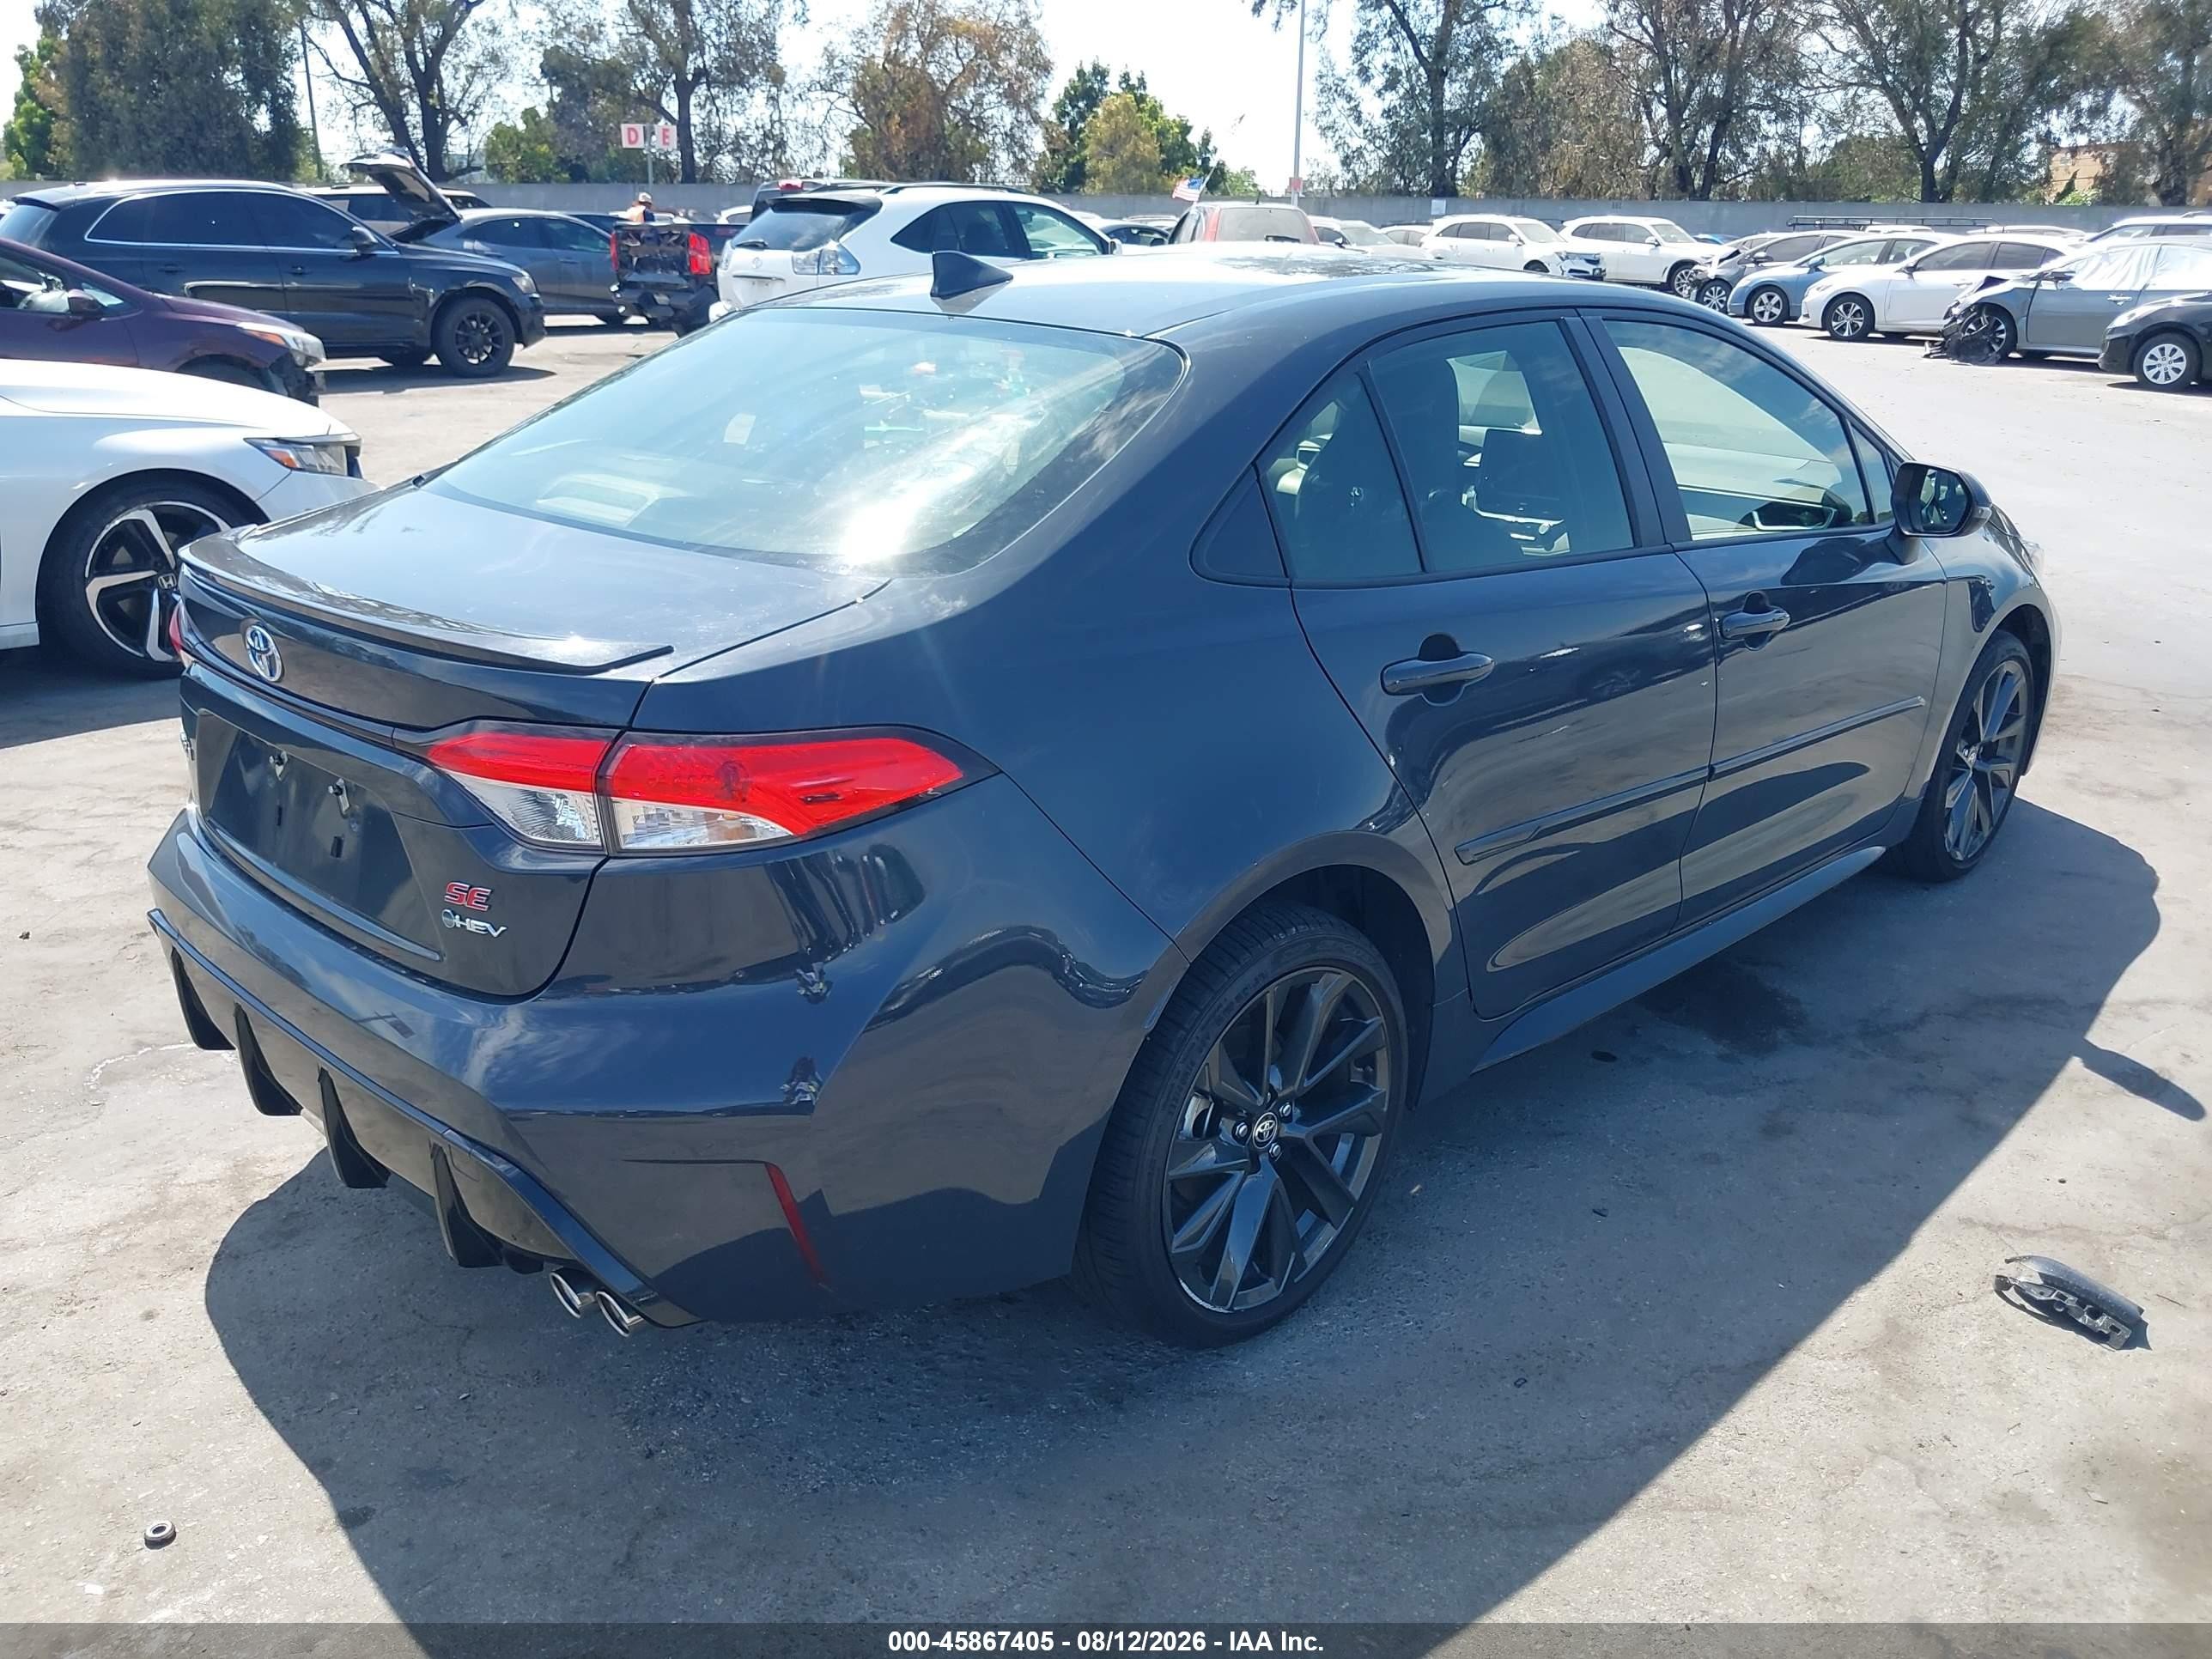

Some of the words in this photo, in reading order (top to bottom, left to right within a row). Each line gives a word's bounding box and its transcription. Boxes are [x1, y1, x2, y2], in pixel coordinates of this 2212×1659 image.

[628, 127, 639, 145] D
[662, 128, 670, 145] E
[444, 882, 492, 911] SE
[453, 915, 507, 937] HEV
